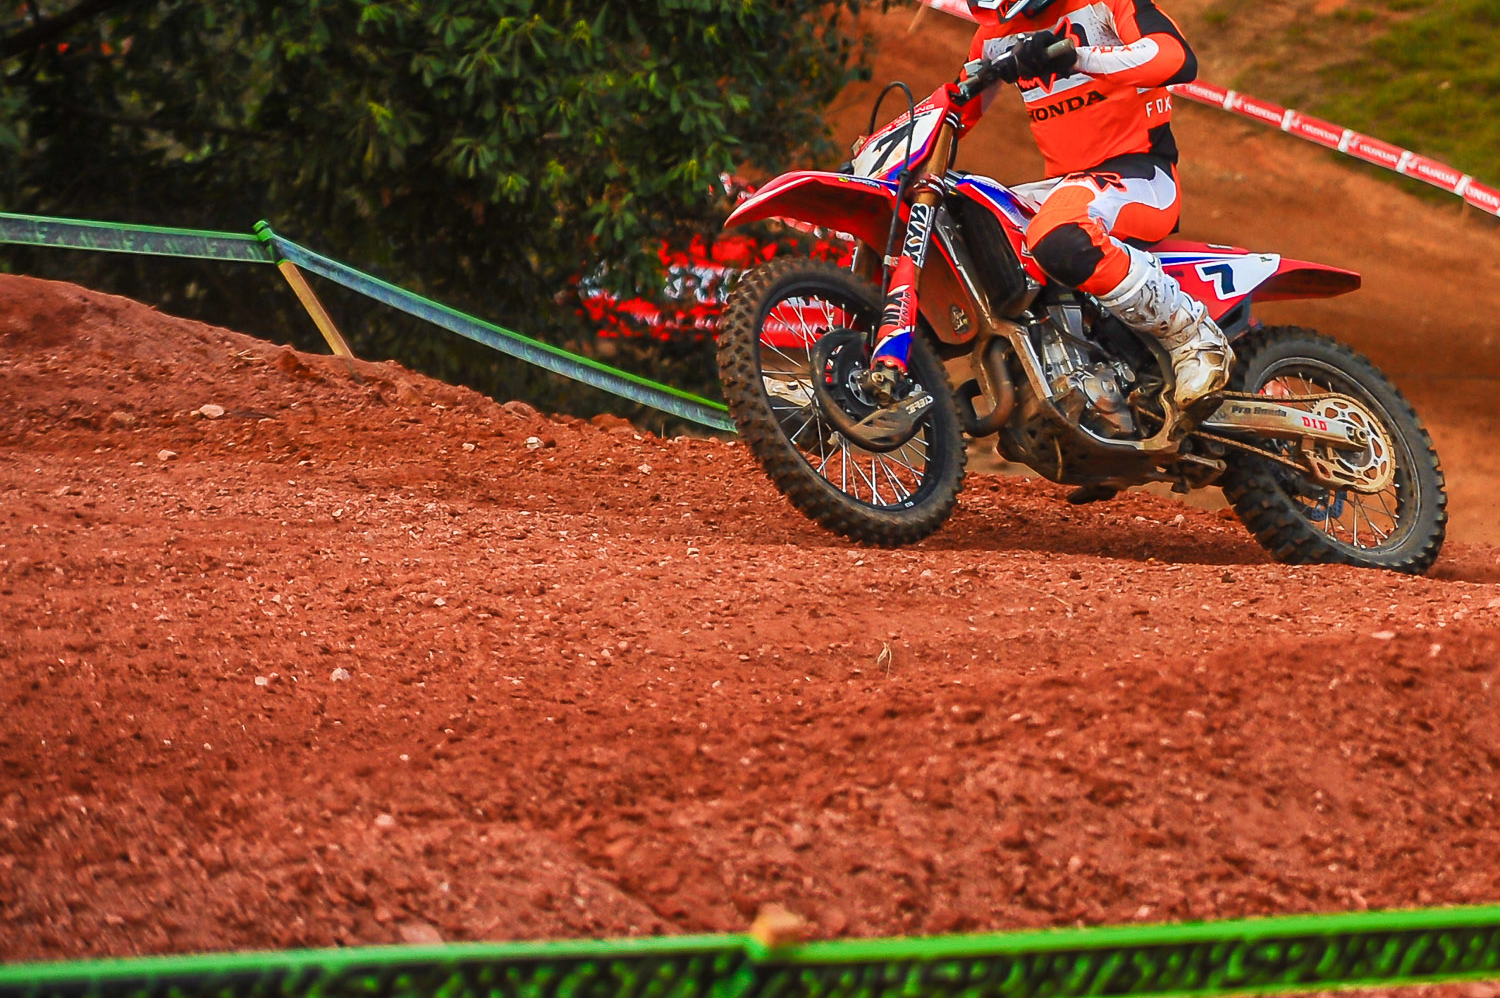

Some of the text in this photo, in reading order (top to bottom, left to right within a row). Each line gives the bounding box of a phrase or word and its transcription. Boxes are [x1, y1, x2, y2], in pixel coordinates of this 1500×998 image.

[1146, 96, 1173, 117] FOX
[867, 119, 919, 177] 7
[1201, 263, 1236, 295] 7
[1301, 416, 1328, 431] DID
